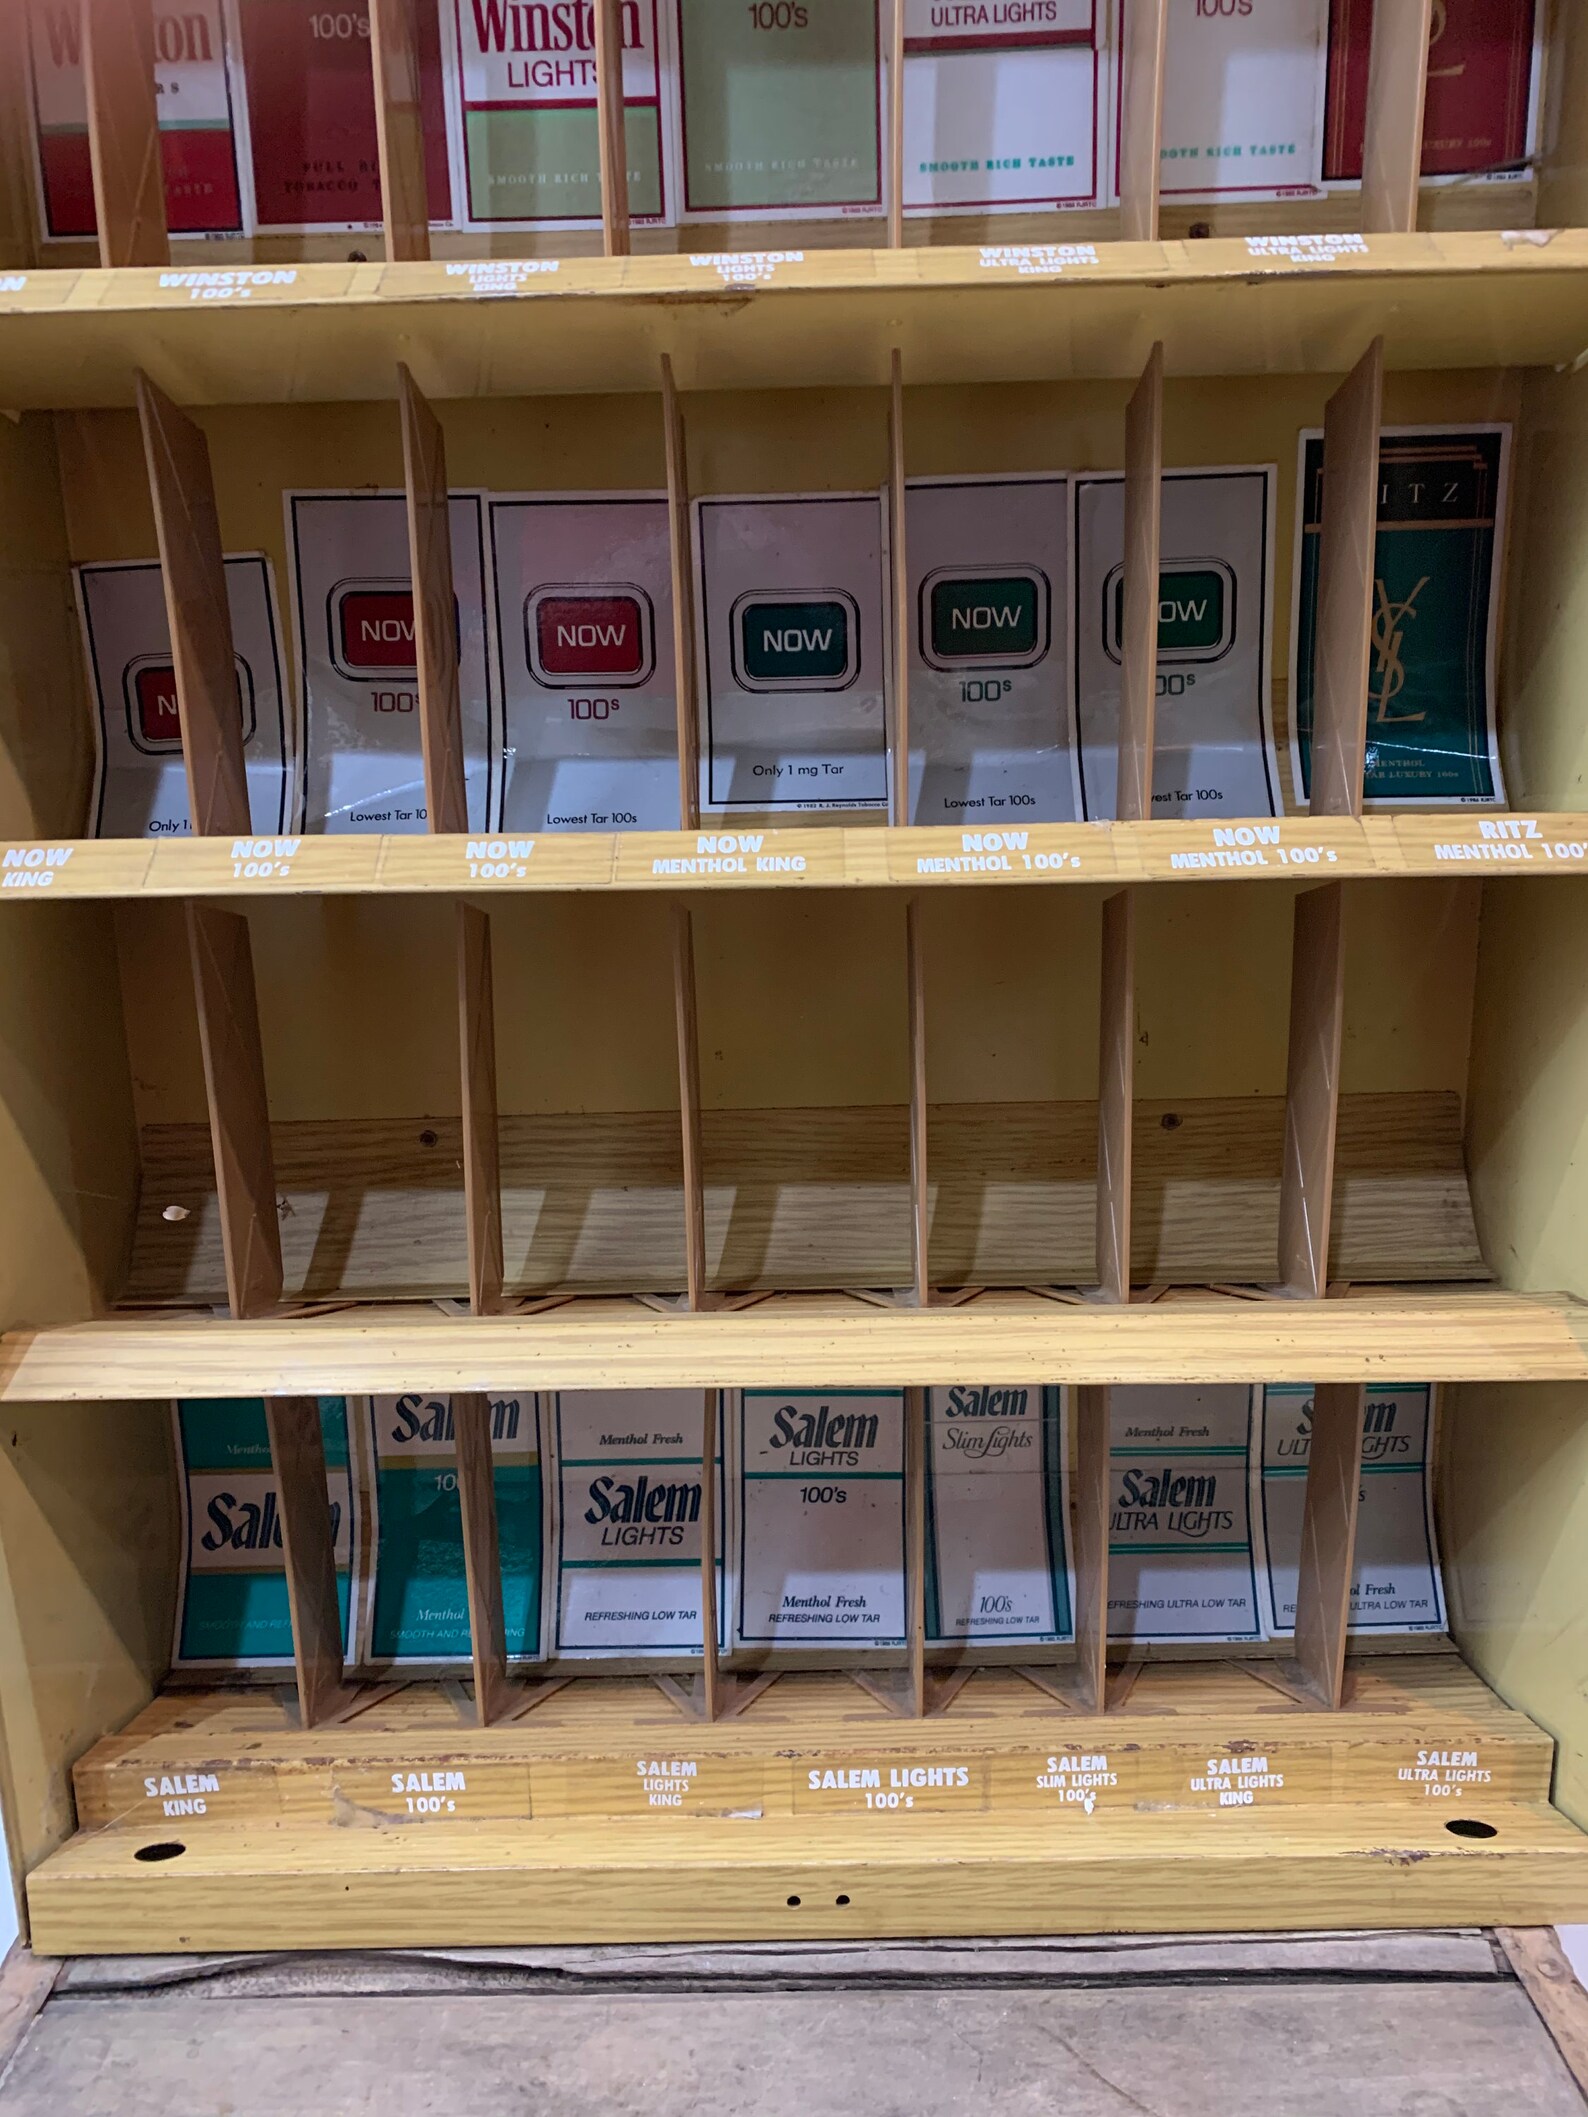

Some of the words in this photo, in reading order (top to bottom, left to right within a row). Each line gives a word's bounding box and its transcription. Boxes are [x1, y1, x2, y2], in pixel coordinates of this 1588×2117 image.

[748, 1, 808, 30] 100's
[931, 4, 988, 27] ULTRA
[993, 1, 1057, 24] LIGHTS
[309, 14, 371, 39] 100's
[1160, 147, 1199, 159] OOTH
[1206, 145, 1242, 157] RICH
[1250, 143, 1296, 156] TASTE
[919, 160, 980, 173] SMOOTH
[986, 158, 1022, 170] RICH
[1028, 155, 1075, 168] TASTE
[1244, 233, 1365, 248] WINSTON
[689, 251, 805, 266] WINSTON
[978, 245, 1097, 259] WINSTON
[1247, 245, 1301, 256] ULTRA
[1309, 244, 1369, 254] LIGHTS
[446, 260, 560, 275] WINSTON
[717, 263, 775, 274] LIGHTS
[979, 257, 1032, 267] ULTRA
[1039, 256, 1100, 266] LIGHTS
[1018, 264, 1063, 274] KING
[159, 270, 297, 288] WINSTON
[469, 273, 528, 284] LIGHTS
[190, 286, 251, 300] 100's
[1379, 481, 1460, 505] ITZ
[952, 605, 1023, 630] NOW
[1158, 599, 1208, 623] OW
[557, 624, 627, 648] NOW
[762, 629, 833, 653] NOW
[1155, 673, 1196, 697] 00s
[752, 764, 784, 778] Only
[787, 764, 793, 776] 1
[799, 765, 819, 777] mg
[822, 763, 844, 776] Tar
[944, 796, 986, 809] Lowest
[988, 795, 1006, 808] Tar
[1008, 795, 1037, 807] 100s
[1174, 790, 1194, 802] Tar
[1195, 788, 1224, 801] 100s
[350, 810, 392, 822] Lowest
[394, 809, 413, 820] Tar
[415, 808, 428, 820] 10
[546, 812, 588, 825] Lowest
[590, 812, 609, 825] Tar
[611, 812, 638, 824] 100s
[148, 818, 180, 833] Only
[183, 819, 188, 830] 1
[1478, 819, 1544, 840] RITZ
[697, 834, 764, 854] NOW
[962, 831, 1029, 852] NOW
[1213, 825, 1281, 847] NOW
[2, 848, 74, 868] NOW
[231, 839, 300, 859] NOW
[465, 839, 535, 860] NOW
[1170, 850, 1269, 869] MENTHOL
[1276, 846, 1338, 865] 100's
[1434, 844, 1533, 861] MENTHOL
[1541, 842, 1588, 860] 100'
[232, 861, 290, 879] 100's
[469, 862, 527, 879] 100's
[652, 857, 748, 875] MENTHOL
[756, 855, 807, 873] KING
[916, 855, 1012, 874] MENTHOL
[1021, 853, 1081, 870] 100's
[1, 871, 54, 887] KING
[945, 1386, 1028, 1417] Salem
[391, 1393, 521, 1443] Salm
[768, 1404, 879, 1449] Salem
[599, 1432, 648, 1446] Menthol
[652, 1432, 684, 1446] Fresh
[1125, 1425, 1175, 1439] Menthol
[1178, 1425, 1210, 1438] Fresh
[1277, 1438, 1312, 1456] ULT
[1361, 1435, 1412, 1460] GHTS
[789, 1450, 860, 1467] LIGHTS
[800, 1486, 848, 1504] 100's
[1118, 1467, 1217, 1508] Salem
[584, 1475, 703, 1525] Salem
[1167, 1510, 1234, 1538] LIGHTS
[600, 1525, 685, 1547] LIGHTS
[1365, 1582, 1396, 1596] Fresh
[782, 1595, 832, 1608] Menthol
[835, 1595, 867, 1608] Fresh
[980, 1595, 1013, 1614] 100's
[1107, 1599, 1165, 1610] EFRESHING
[1166, 1599, 1200, 1609] ULTRA
[1201, 1599, 1225, 1608] LOW
[1228, 1598, 1247, 1608] TAR
[1384, 1600, 1407, 1610] LOW
[1410, 1599, 1429, 1609] TAR
[415, 1607, 466, 1621] Menthol
[584, 1611, 650, 1622] REFRESHING
[651, 1611, 676, 1621] LOW
[678, 1610, 697, 1620] TAR
[768, 1613, 834, 1624] REFRESHING
[835, 1613, 859, 1624] LOW
[861, 1613, 881, 1623] TAR
[955, 1618, 1004, 1627] REFRESHING
[1005, 1616, 1023, 1625] LOW
[1025, 1616, 1040, 1624] TAR
[436, 1629, 460, 1639] AND
[1047, 1755, 1108, 1773] SALEM
[1207, 1756, 1269, 1776] SALEM
[1417, 1749, 1478, 1768] SALEM
[636, 1760, 698, 1777] SALEM
[1398, 1768, 1441, 1784] ULTRA
[1445, 1768, 1492, 1784] LIGHTS
[144, 1773, 219, 1798] SALEM
[391, 1771, 467, 1793] SALEM
[643, 1778, 690, 1792] LIGHTS
[808, 1769, 880, 1790] SALEM
[890, 1766, 970, 1788] LIGHTS
[1036, 1774, 1067, 1789] SLIM
[1071, 1772, 1118, 1787] LIGHTS
[1190, 1776, 1232, 1792] ULTRA
[1237, 1774, 1284, 1789] LIGHTS
[1057, 1787, 1097, 1803] 100's
[1219, 1791, 1254, 1807] KING
[1424, 1783, 1463, 1798] 100's
[162, 1797, 207, 1817] KING
[404, 1796, 457, 1814] 100's
[648, 1793, 683, 1807] KING
[864, 1791, 914, 1809] 100's
